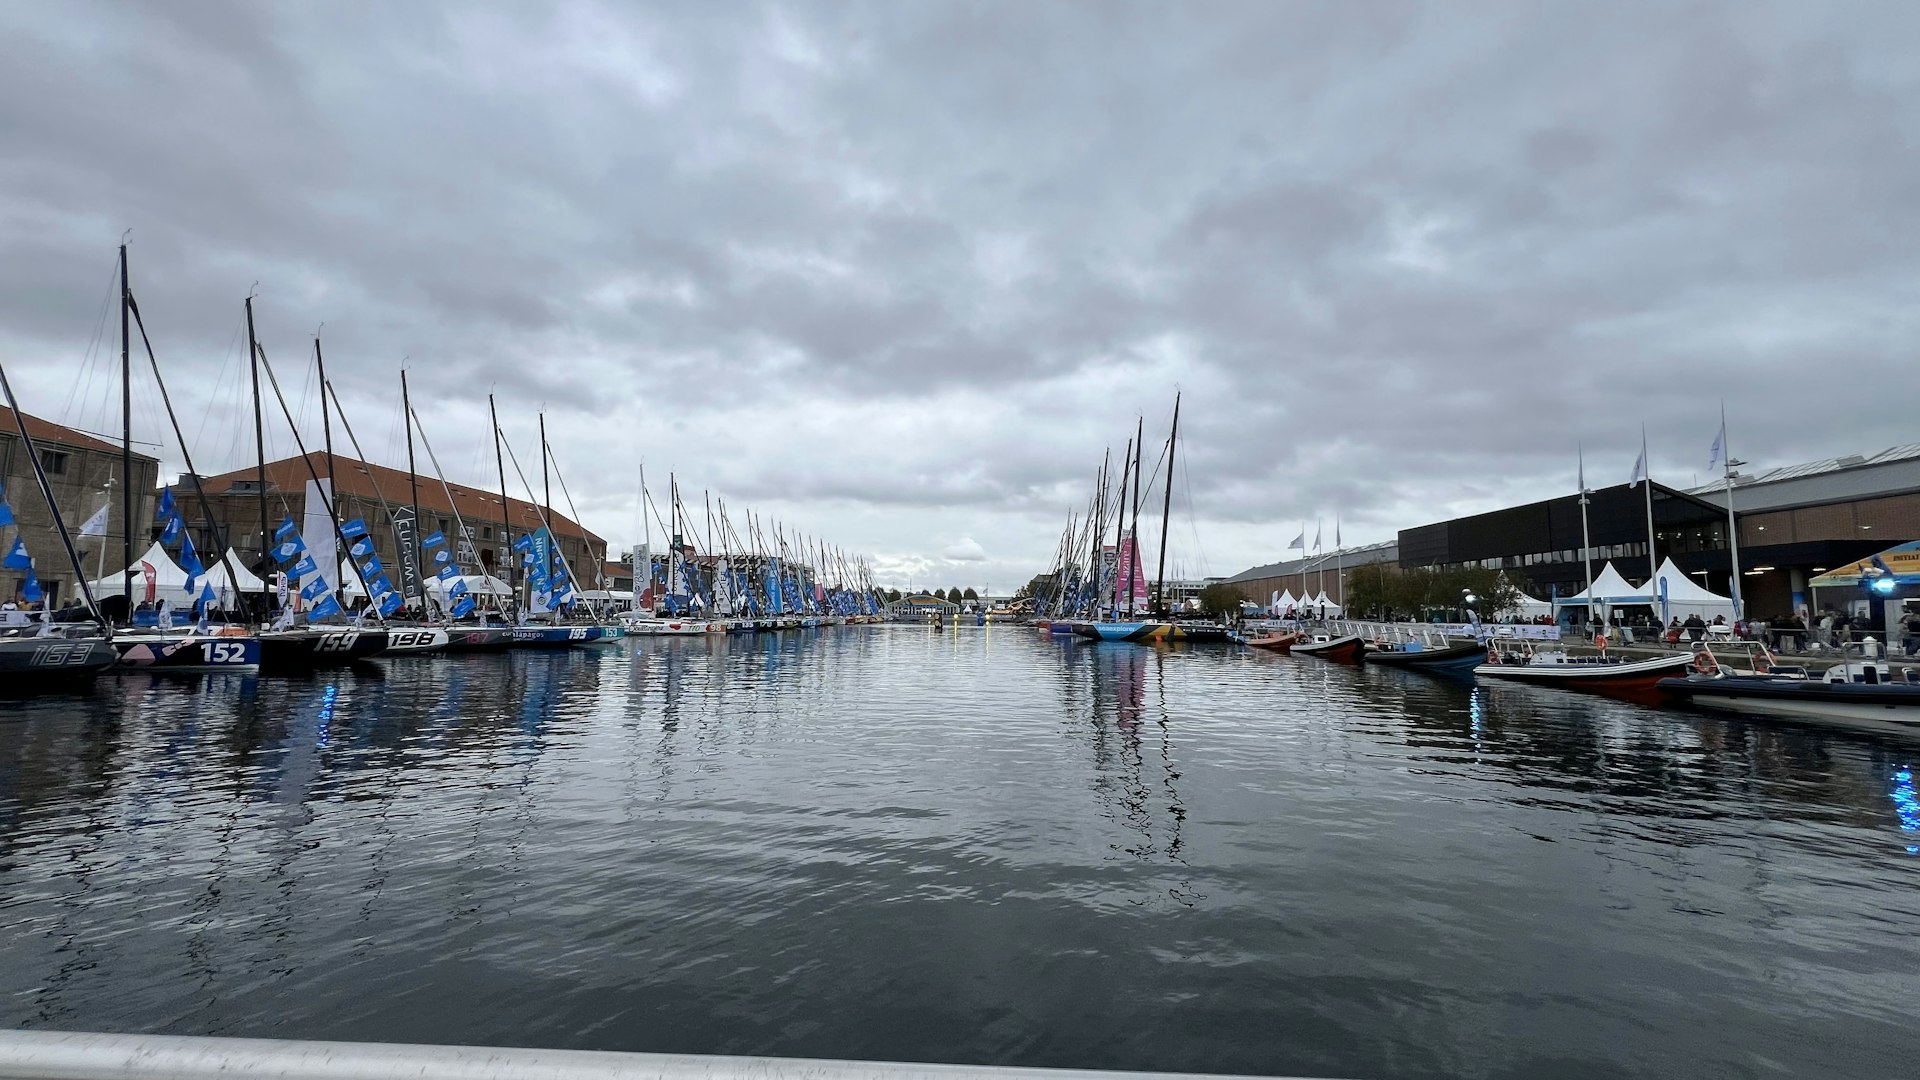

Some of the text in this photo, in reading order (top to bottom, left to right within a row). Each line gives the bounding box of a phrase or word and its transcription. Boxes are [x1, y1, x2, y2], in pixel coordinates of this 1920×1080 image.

[391, 632, 436, 647] 198
[568, 628, 587, 639] 195
[604, 628, 617, 637] 153
[313, 633, 360, 652] 159
[29, 642, 96, 666] 163
[200, 643, 245, 662] 152
